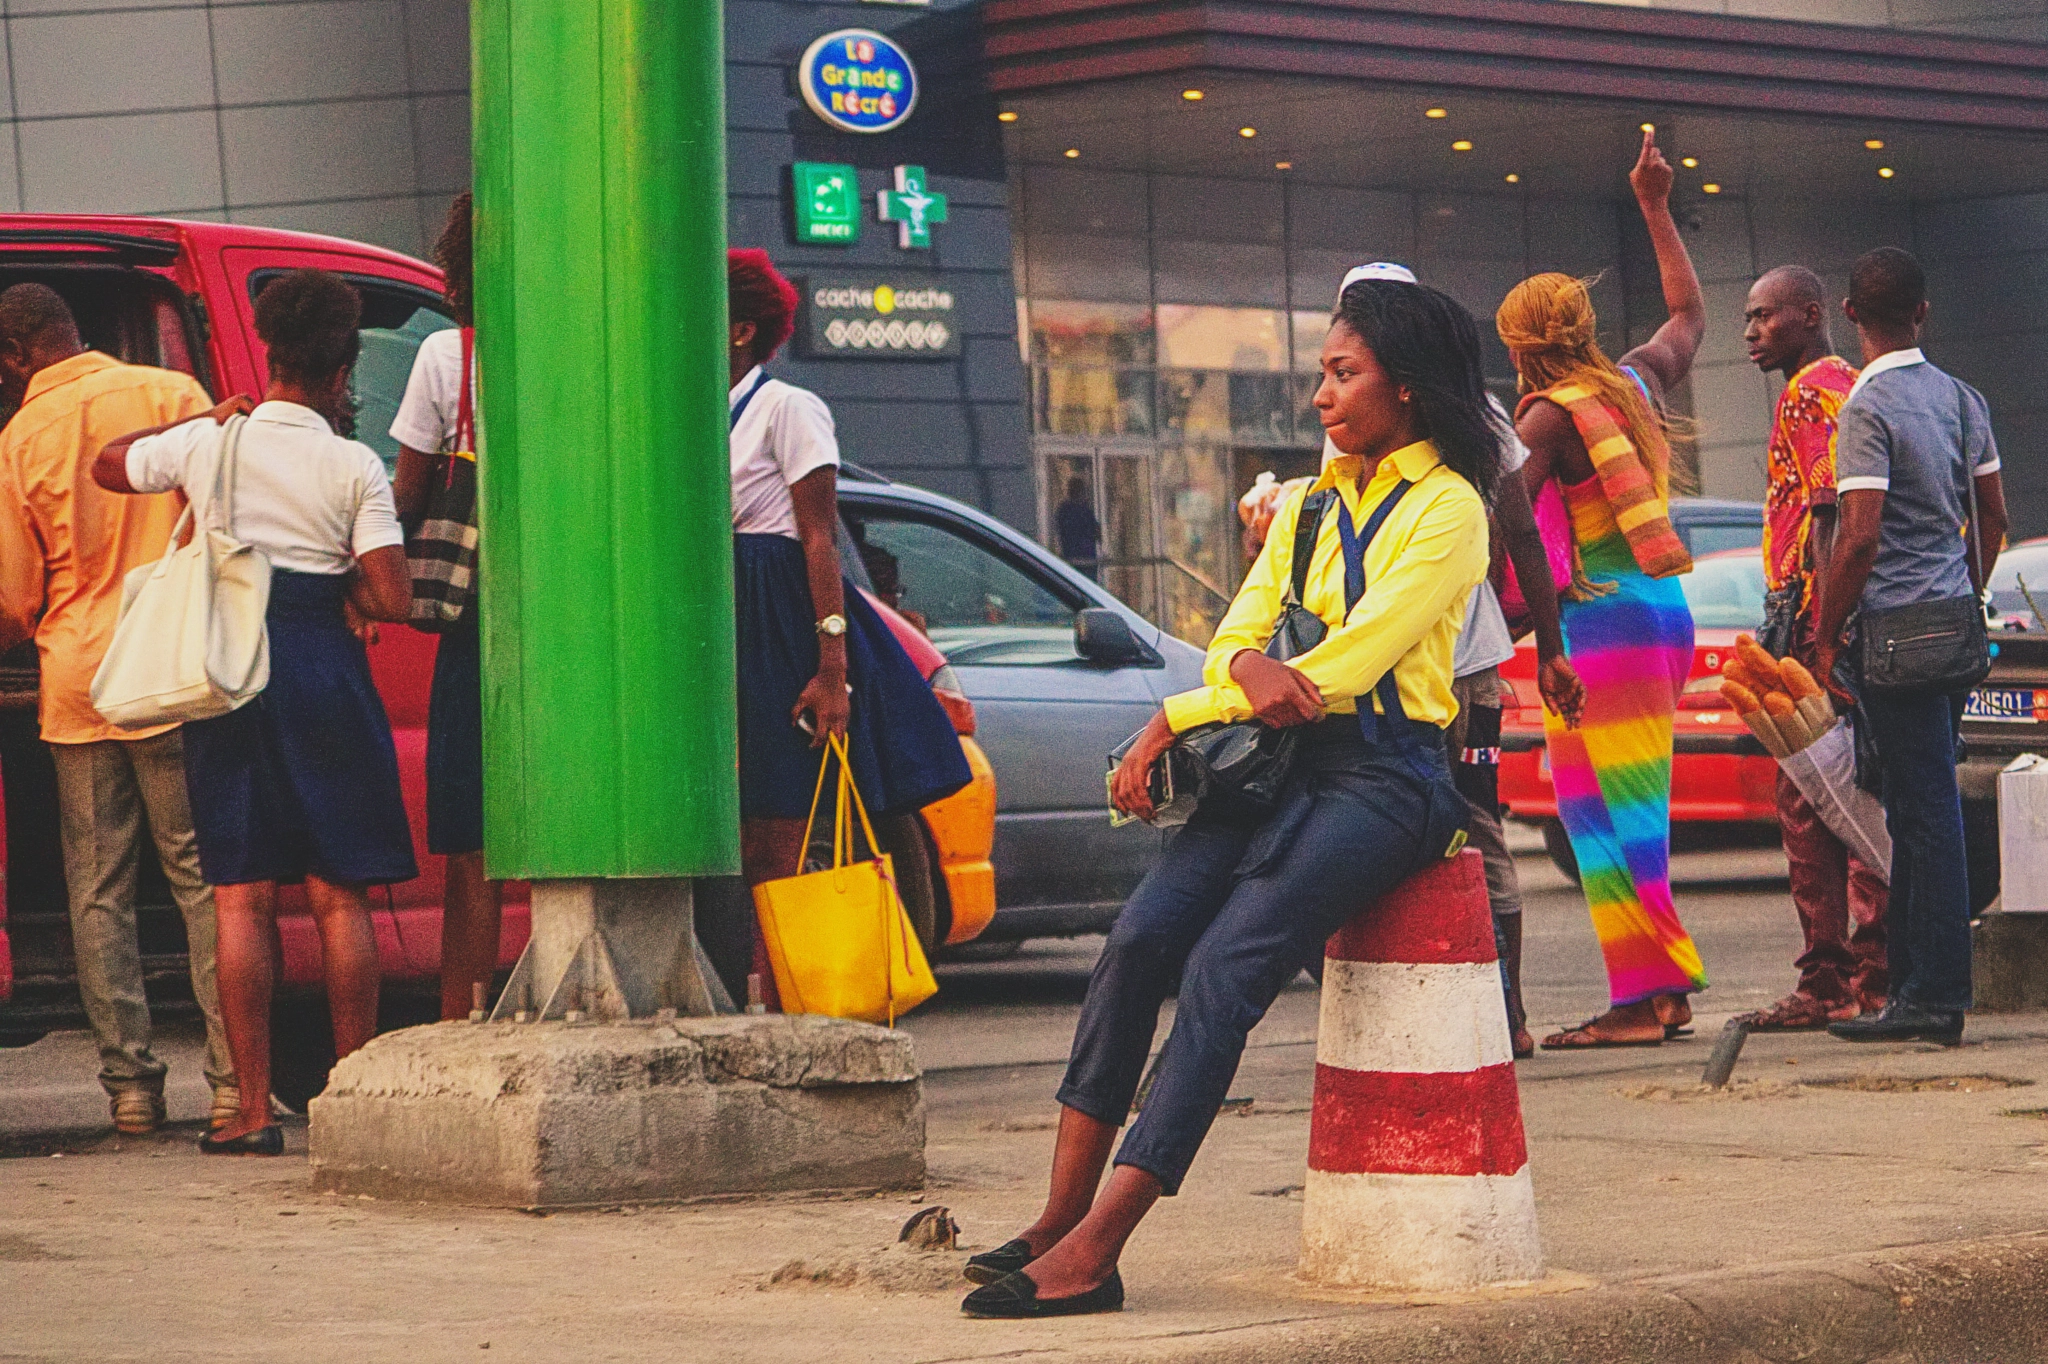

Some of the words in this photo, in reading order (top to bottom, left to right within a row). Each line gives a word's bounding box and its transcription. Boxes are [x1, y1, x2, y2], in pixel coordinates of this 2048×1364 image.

[845, 39, 875, 64] La
[822, 63, 903, 92] Grande
[831, 90, 897, 118] Récré
[815, 286, 873, 308] cache
[894, 288, 954, 310] cache
